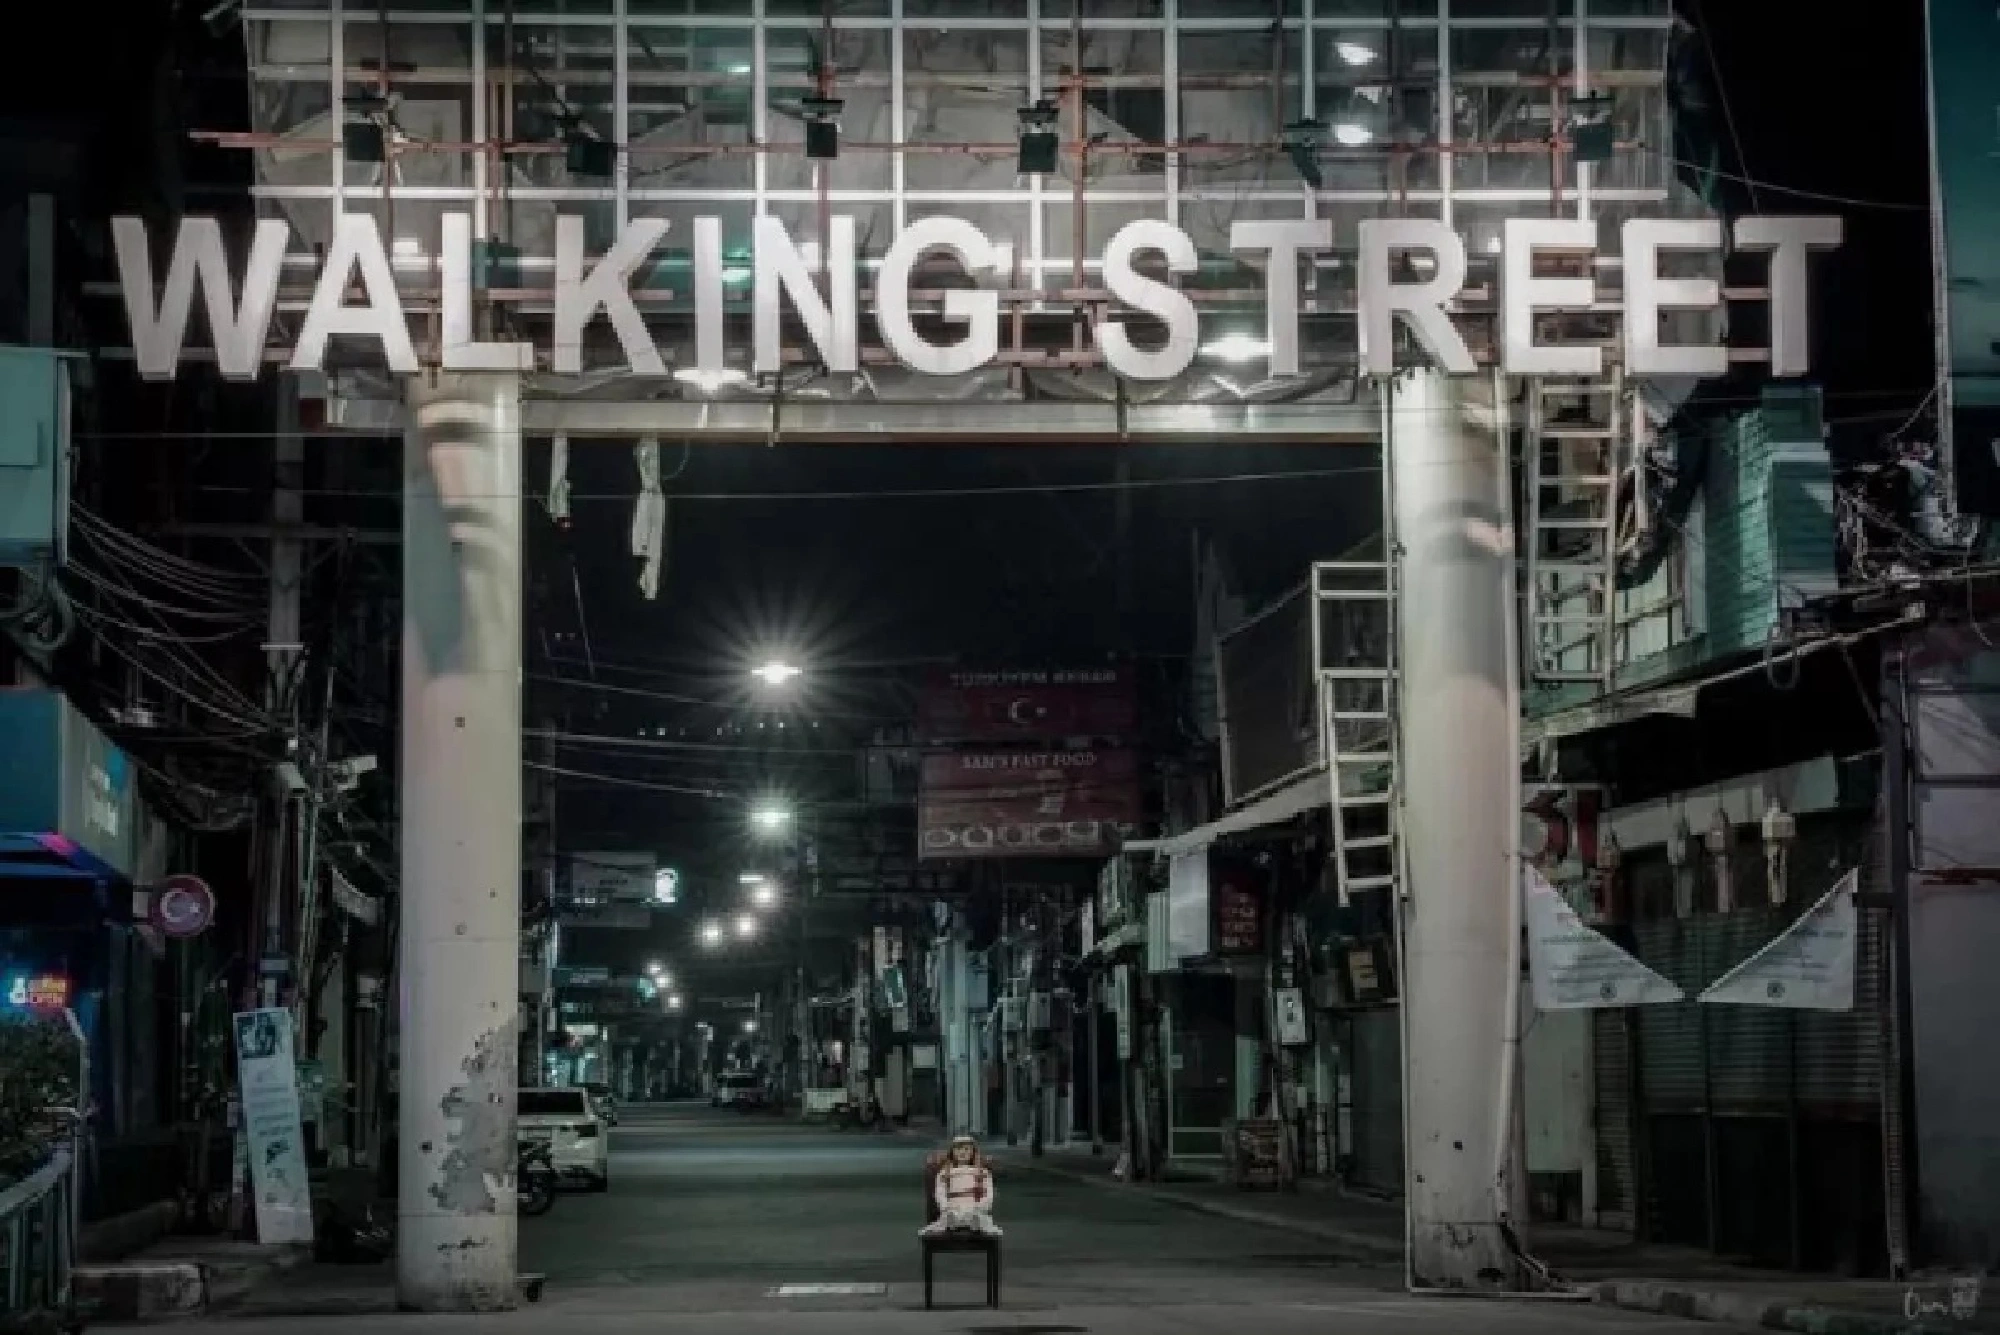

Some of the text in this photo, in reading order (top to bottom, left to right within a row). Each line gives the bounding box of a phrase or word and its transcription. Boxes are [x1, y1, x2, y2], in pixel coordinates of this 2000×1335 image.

[112, 212, 1844, 380] WALKING STREET
[1053, 752, 1097, 767] FOOD
